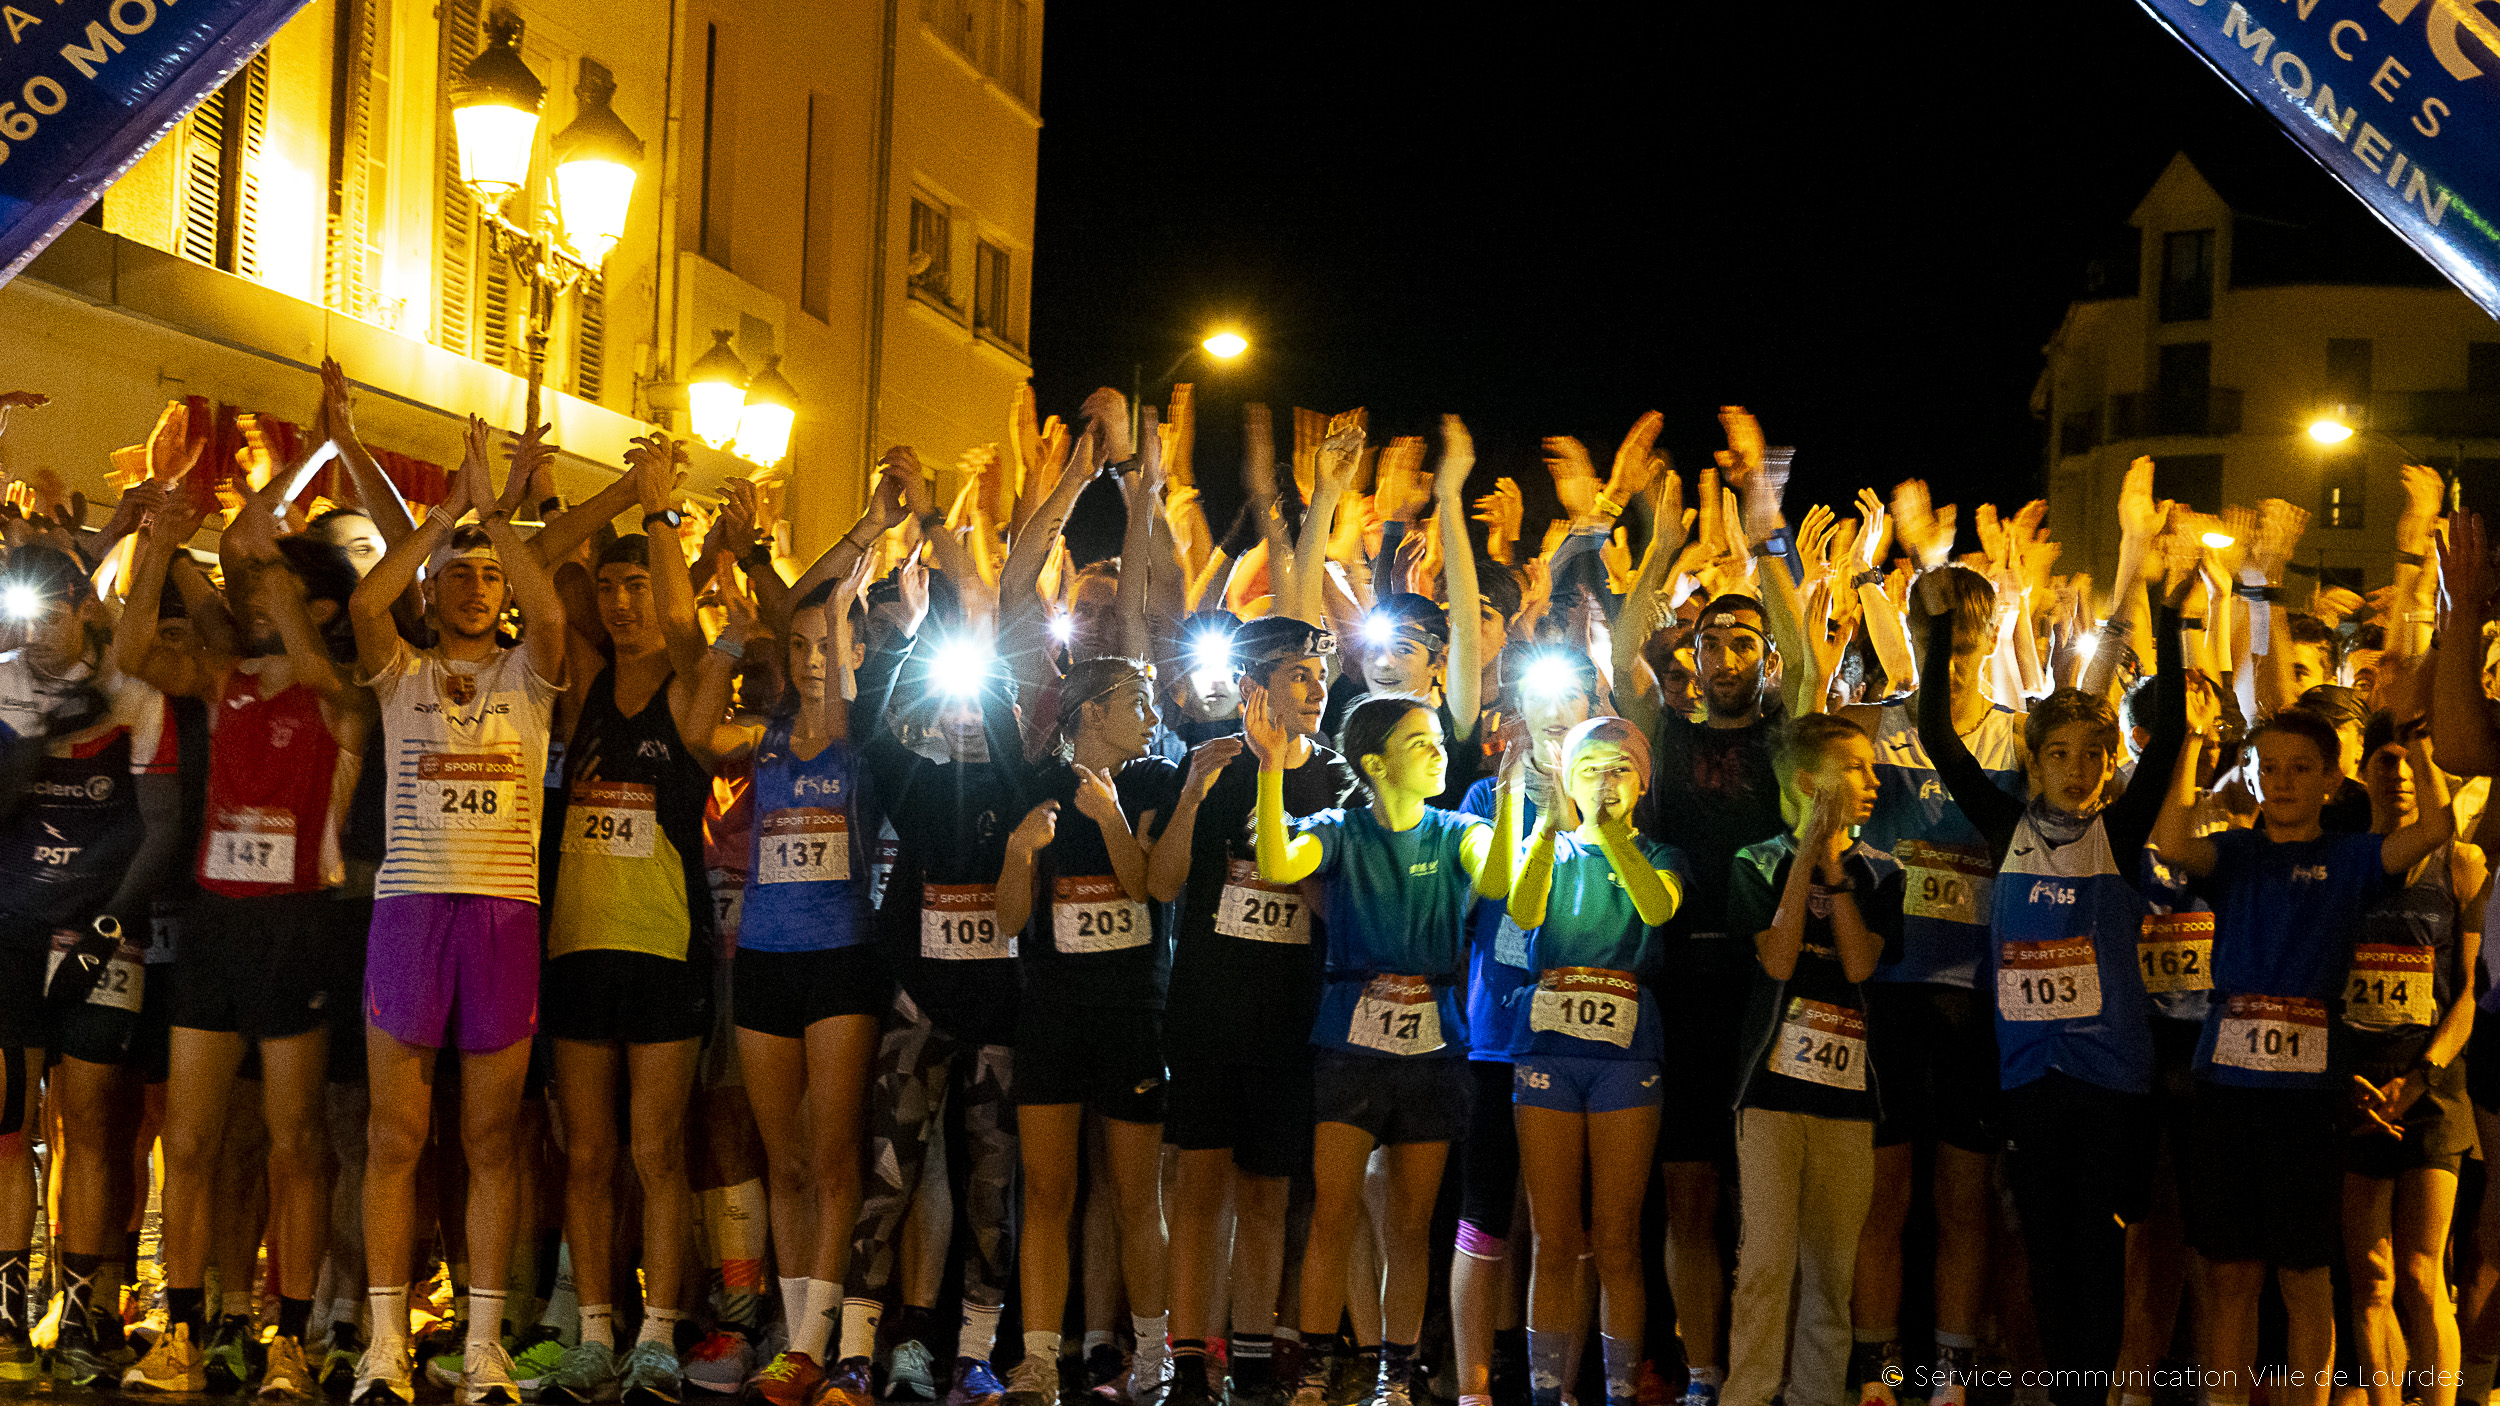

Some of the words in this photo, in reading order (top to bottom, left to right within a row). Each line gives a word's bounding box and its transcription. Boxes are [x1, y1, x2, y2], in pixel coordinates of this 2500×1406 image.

[60, 0, 178, 80] MO
[2222, 2, 2451, 228] MONEIN
[445, 763, 483, 773] SPORT
[486, 763, 514, 773] 2000
[441, 788, 497, 815] 248
[591, 789, 621, 800] SPORT
[622, 791, 654, 802] 2000
[584, 815, 633, 841] 294
[776, 817, 810, 827] SPORT
[813, 815, 846, 825] 2000
[226, 840, 273, 868] 147
[777, 842, 827, 868] 137
[1919, 850, 1960, 863] SPORT
[940, 893, 978, 905] SPORT
[1076, 884, 1116, 896] SPORT
[1923, 876, 1961, 905] 90
[1078, 908, 1133, 937] 203
[1242, 898, 1299, 929] 207
[942, 919, 995, 944] 109
[2142, 923, 2180, 935] SPORT
[2183, 921, 2215, 932] 2000
[2020, 951, 2056, 961] SPORT
[2058, 946, 2093, 958] 2000
[2142, 950, 2200, 977] 162
[2356, 952, 2396, 962] SPORT
[2398, 954, 2432, 964] 2000
[1564, 975, 1604, 985] SPORT
[2020, 976, 2077, 1005] 103
[2353, 979, 2408, 1006] 214
[1561, 998, 1617, 1027] 102
[1806, 1008, 1845, 1026] SPORT
[1795, 1036, 1849, 1072] 240
[2246, 1028, 2300, 1057] 101
